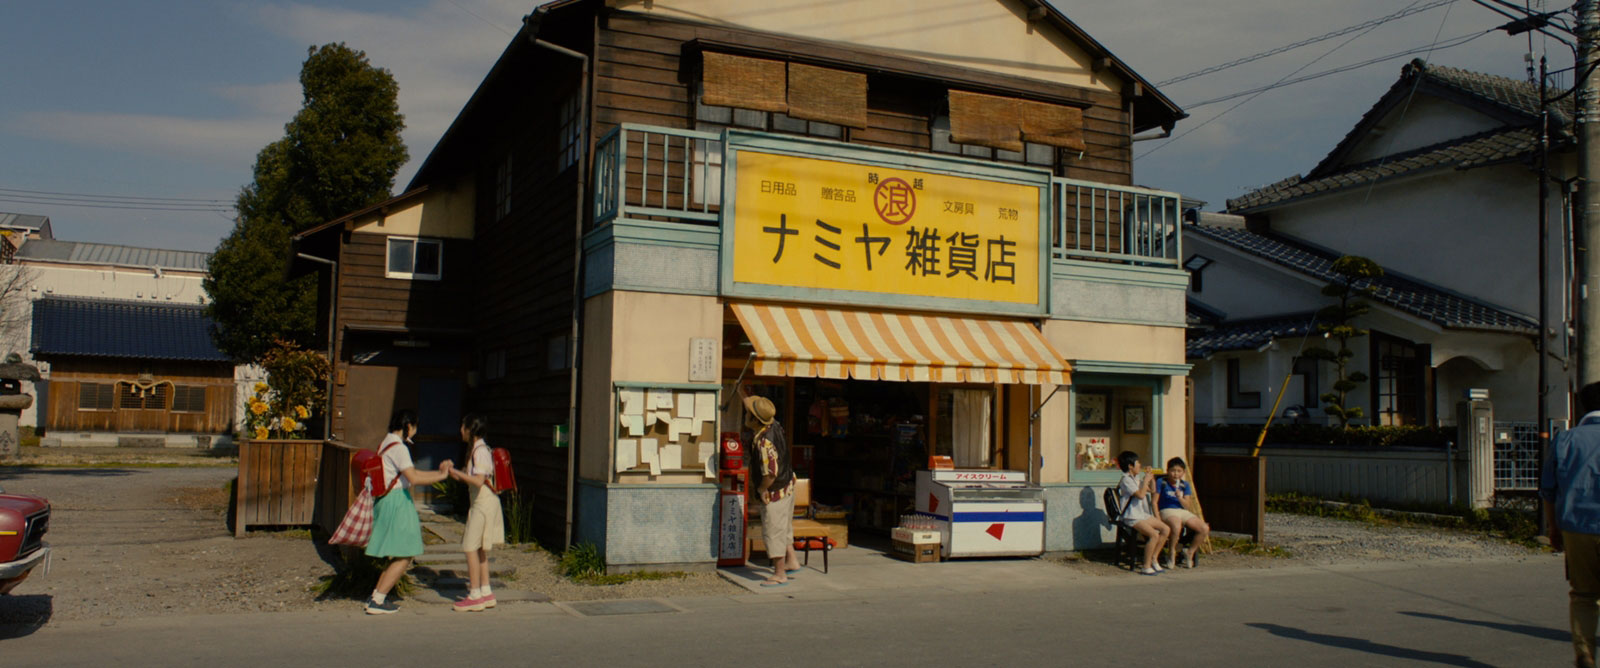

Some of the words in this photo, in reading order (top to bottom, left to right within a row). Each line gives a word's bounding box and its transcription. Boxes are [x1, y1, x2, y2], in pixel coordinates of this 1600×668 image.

[868, 172, 879, 184] 時
[761, 180, 797, 196] 日用品
[821, 187, 856, 203] 贈答品
[877, 182, 911, 218] 浪
[943, 200, 975, 216] 文房具
[998, 207, 1018, 221] 荒物
